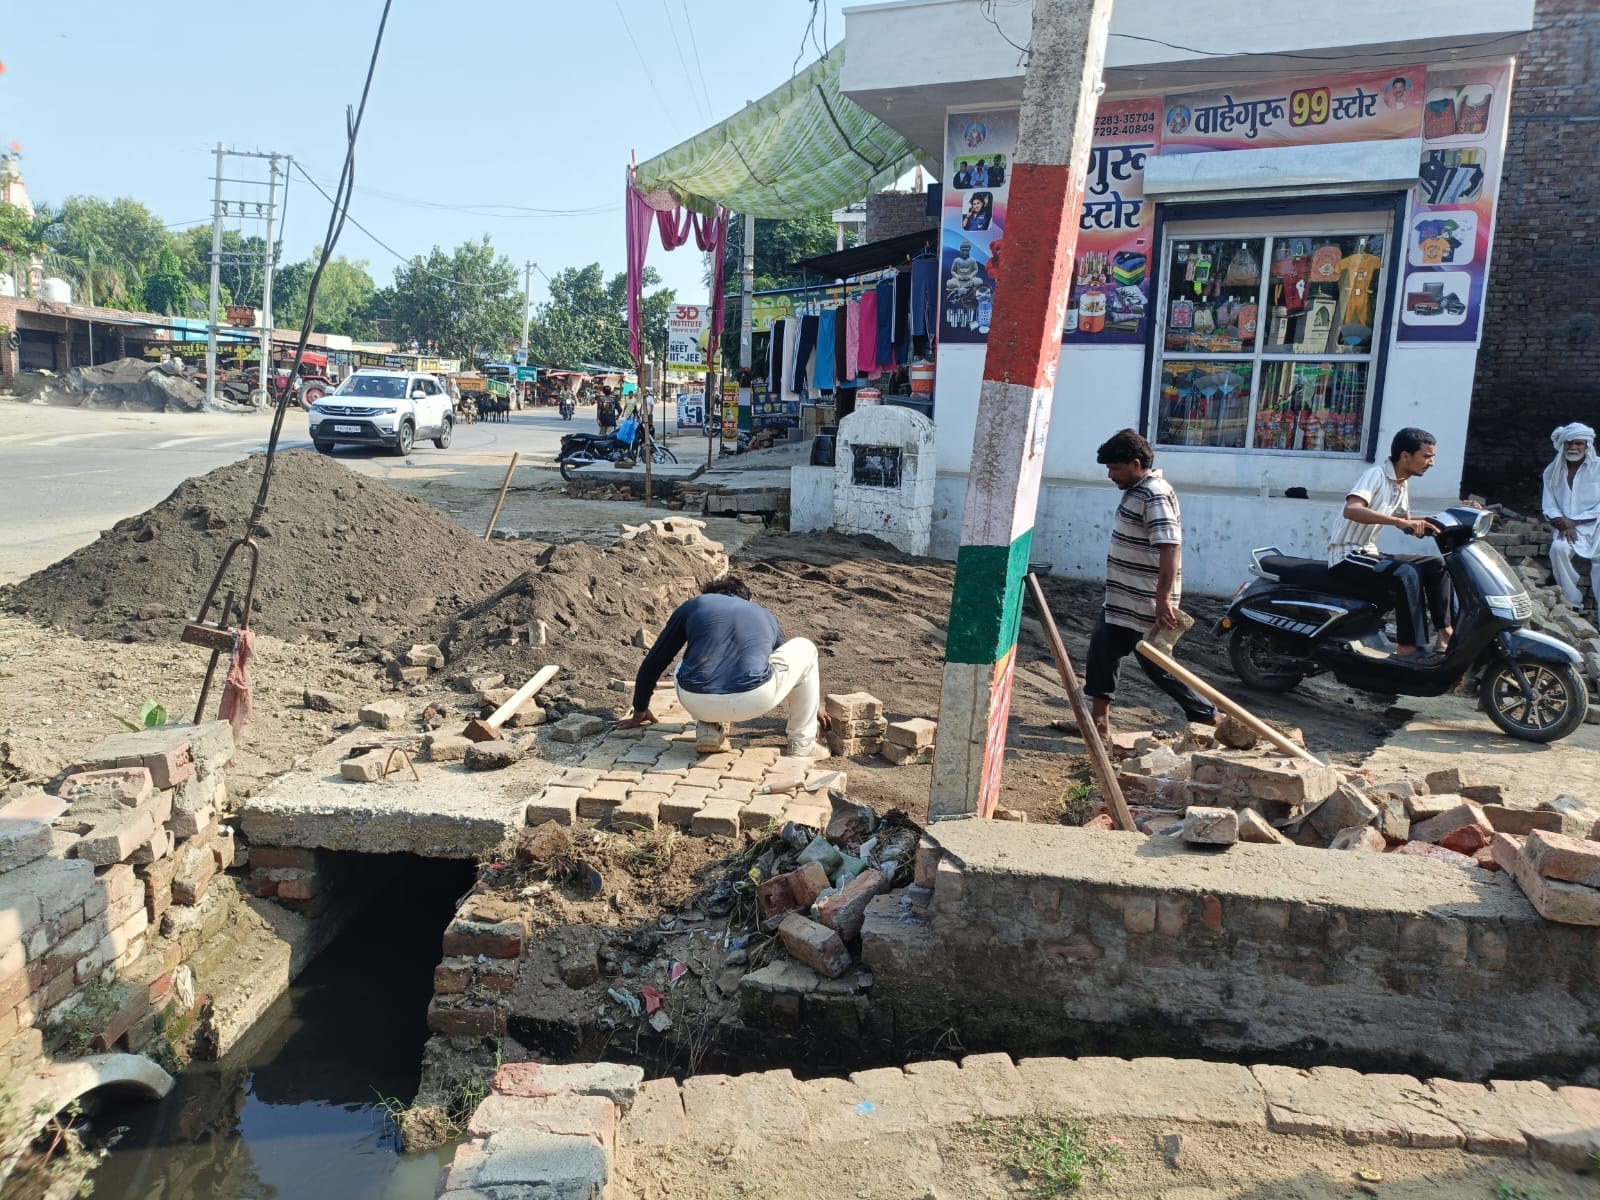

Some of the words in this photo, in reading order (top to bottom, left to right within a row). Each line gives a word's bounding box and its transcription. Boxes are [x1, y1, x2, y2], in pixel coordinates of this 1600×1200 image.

[1095, 112, 1155, 125] 7283-35704
[1194, 95, 1287, 139] वाहेगुरू
[1293, 90, 1329, 124] 99
[1332, 88, 1378, 120] स्टोर
[1094, 124, 1154, 136] 7292-40849
[1087, 144, 1154, 195] गुरू
[1079, 191, 1143, 229] स्टोर
[676, 306, 699, 320] 3D
[669, 344, 688, 352] NEET
[669, 353, 700, 362] IIT-JEE
